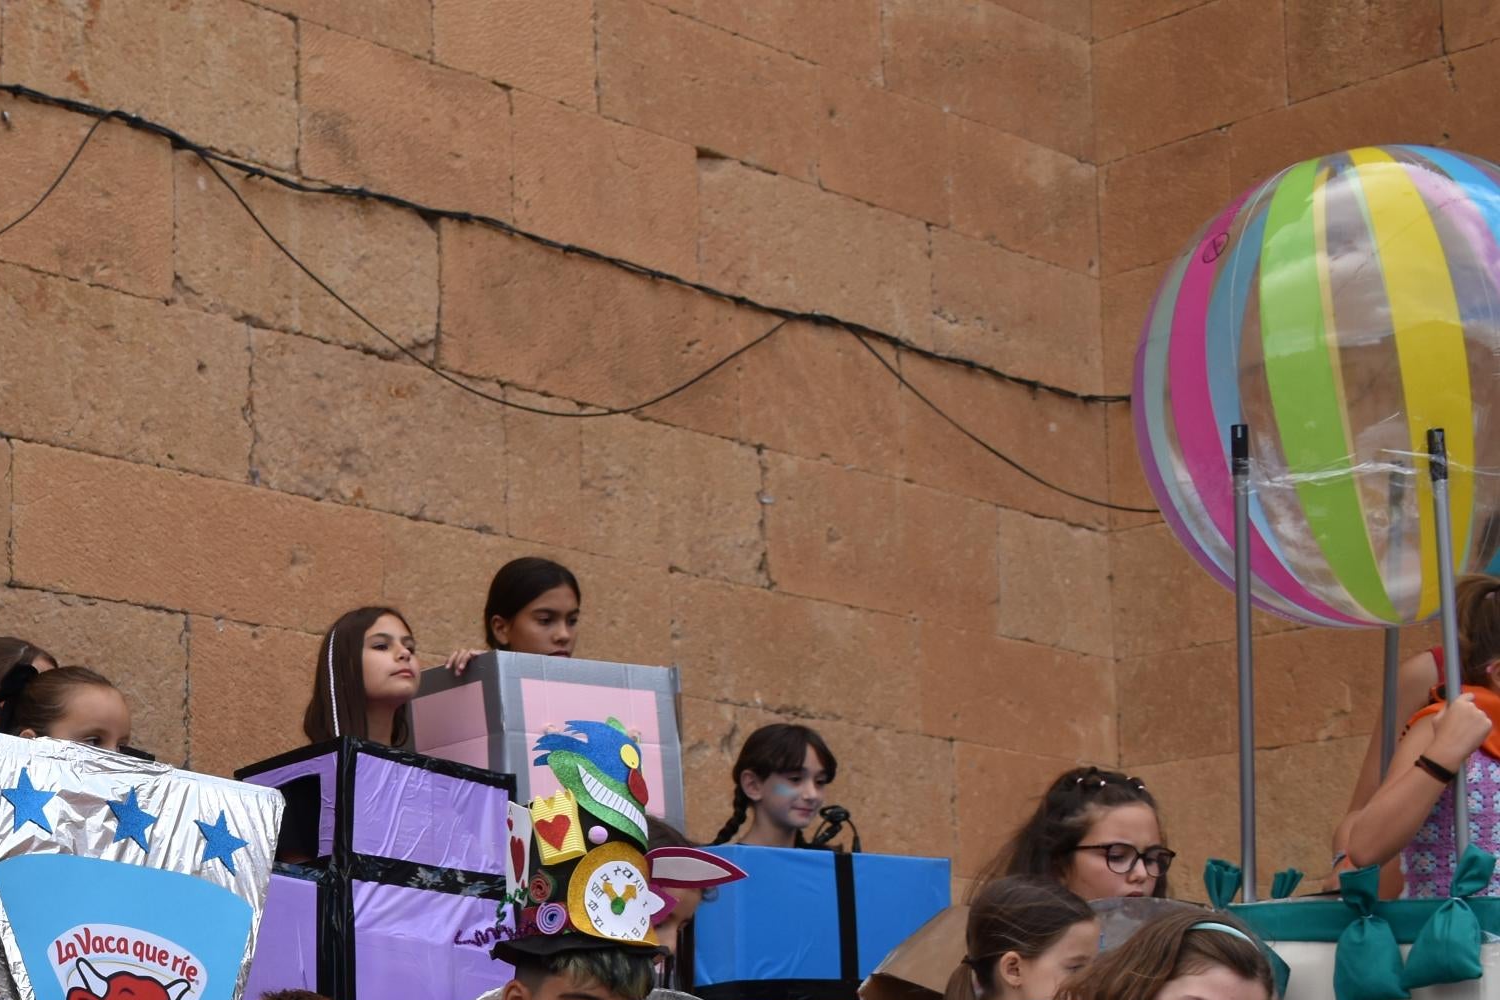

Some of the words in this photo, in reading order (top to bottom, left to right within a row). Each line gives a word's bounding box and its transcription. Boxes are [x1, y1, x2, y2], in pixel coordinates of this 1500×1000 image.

[55, 940, 78, 965] La
[73, 927, 129, 955] Vaca
[132, 940, 169, 967] que
[171, 955, 198, 982] ríe
